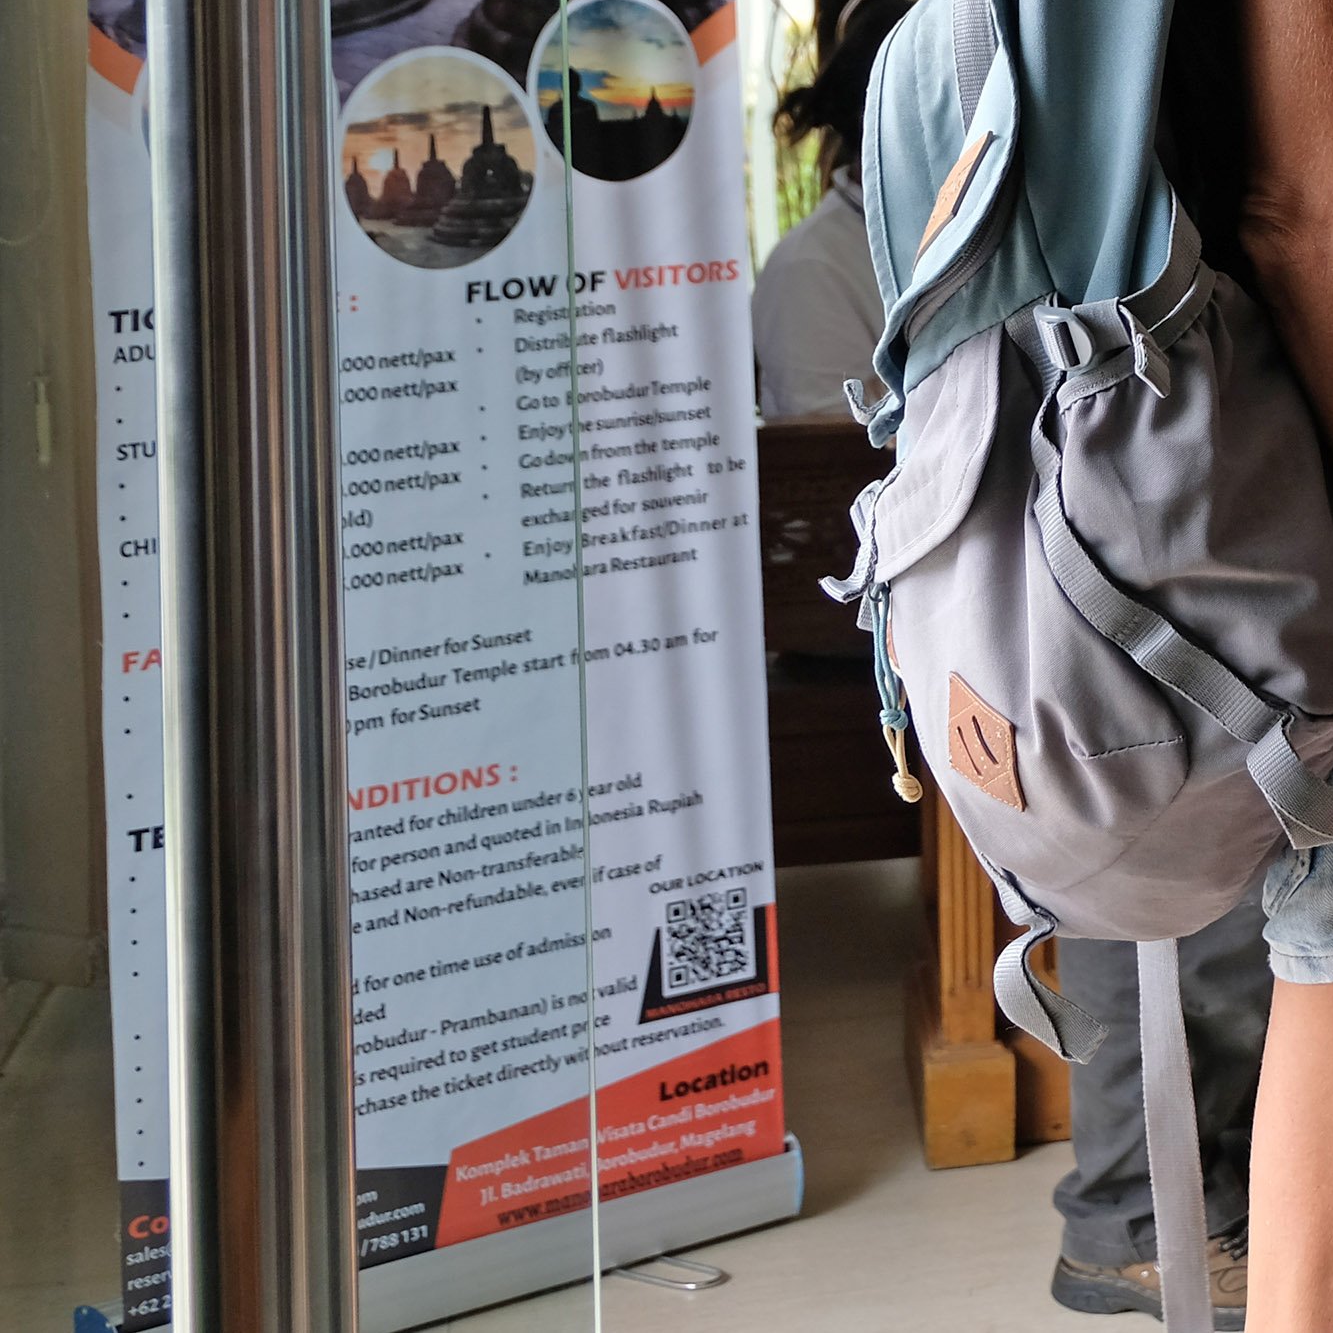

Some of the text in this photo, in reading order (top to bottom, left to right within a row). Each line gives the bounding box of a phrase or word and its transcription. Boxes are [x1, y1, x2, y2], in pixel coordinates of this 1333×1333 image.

[466, 259, 739, 303] FLOW OF VISITORS
[602, 323, 678, 343] flashlight
[379, 348, 456, 368] nett/pax
[546, 359, 604, 378] offcer)
[381, 379, 459, 399] nett/pax
[516, 395, 540, 410] Go
[542, 395, 560, 408] to
[651, 376, 711, 395] Temple
[518, 422, 565, 441] Enjoy
[597, 406, 711, 430] sunrise/sunset
[383, 440, 461, 461] nett/pax
[518, 453, 542, 468] Go
[591, 444, 632, 459] from
[634, 439, 658, 454] the
[661, 431, 720, 451] temple
[384, 471, 462, 491] nett/pax
[583, 473, 610, 489] the
[617, 462, 693, 485] flashlight
[707, 462, 723, 474] to
[727, 455, 746, 471] be
[612, 498, 636, 514] for
[642, 489, 708, 511] souvenir
[386, 531, 464, 553] nett/pax
[522, 538, 573, 556] Enjoy
[733, 513, 749, 526] at
[386, 562, 464, 584] nett/pax
[610, 548, 697, 572] Restaurant
[349, 672, 447, 701] Borobudur
[452, 658, 518, 684] Temple
[523, 654, 564, 672] start
[613, 637, 660, 656] 04.30
[664, 634, 688, 649] am
[692, 627, 719, 644] for
[378, 645, 440, 665] Dinner
[444, 637, 469, 655] for
[471, 629, 532, 651] Sunset
[354, 716, 384, 736] pm
[390, 707, 416, 725] for
[418, 697, 481, 721] Sunset
[348, 763, 500, 811] NDITIONS
[350, 818, 404, 842] ranted
[409, 815, 435, 832] for
[437, 803, 509, 826] children
[511, 789, 562, 812] under
[565, 788, 577, 802] 6
[616, 772, 643, 791] old
[352, 856, 377, 873] for
[381, 846, 441, 871] person
[444, 834, 478, 854] and
[480, 821, 542, 850] quoted
[545, 819, 561, 835] in
[647, 790, 703, 814] Rupiah
[351, 845, 584, 903] hased are Non-transferable
[365, 909, 400, 931] and
[404, 881, 548, 923] Non-refundable,
[592, 865, 605, 883] if
[607, 863, 641, 879] case
[644, 854, 663, 871] of
[649, 860, 764, 894] OUR LOCATION
[363, 975, 390, 992] for
[393, 968, 427, 986] one
[429, 959, 470, 978] time
[474, 951, 503, 968] use
[505, 942, 525, 961] of
[527, 928, 612, 957] admisson
[355, 974, 638, 1055] robudur Prambanan) is no valid
[370, 1050, 446, 1082] required
[450, 1049, 467, 1063] to
[470, 1040, 498, 1062] get
[501, 1024, 567, 1051] student
[571, 1014, 611, 1039] prce
[411, 1084, 441, 1103] the
[443, 1072, 493, 1095] ticket
[495, 1054, 562, 1082] directly
[631, 1016, 726, 1047] reservation.
[659, 1060, 769, 1101] Location
[455, 1149, 530, 1182] Komplek
[532, 1138, 589, 1161] Taman
[647, 1105, 693, 1130] Candi
[694, 1088, 776, 1119] Borobudur
[597, 1140, 679, 1171] orobudur,
[680, 1120, 756, 1149] Magelang
[400, 1225, 428, 1243] 131
